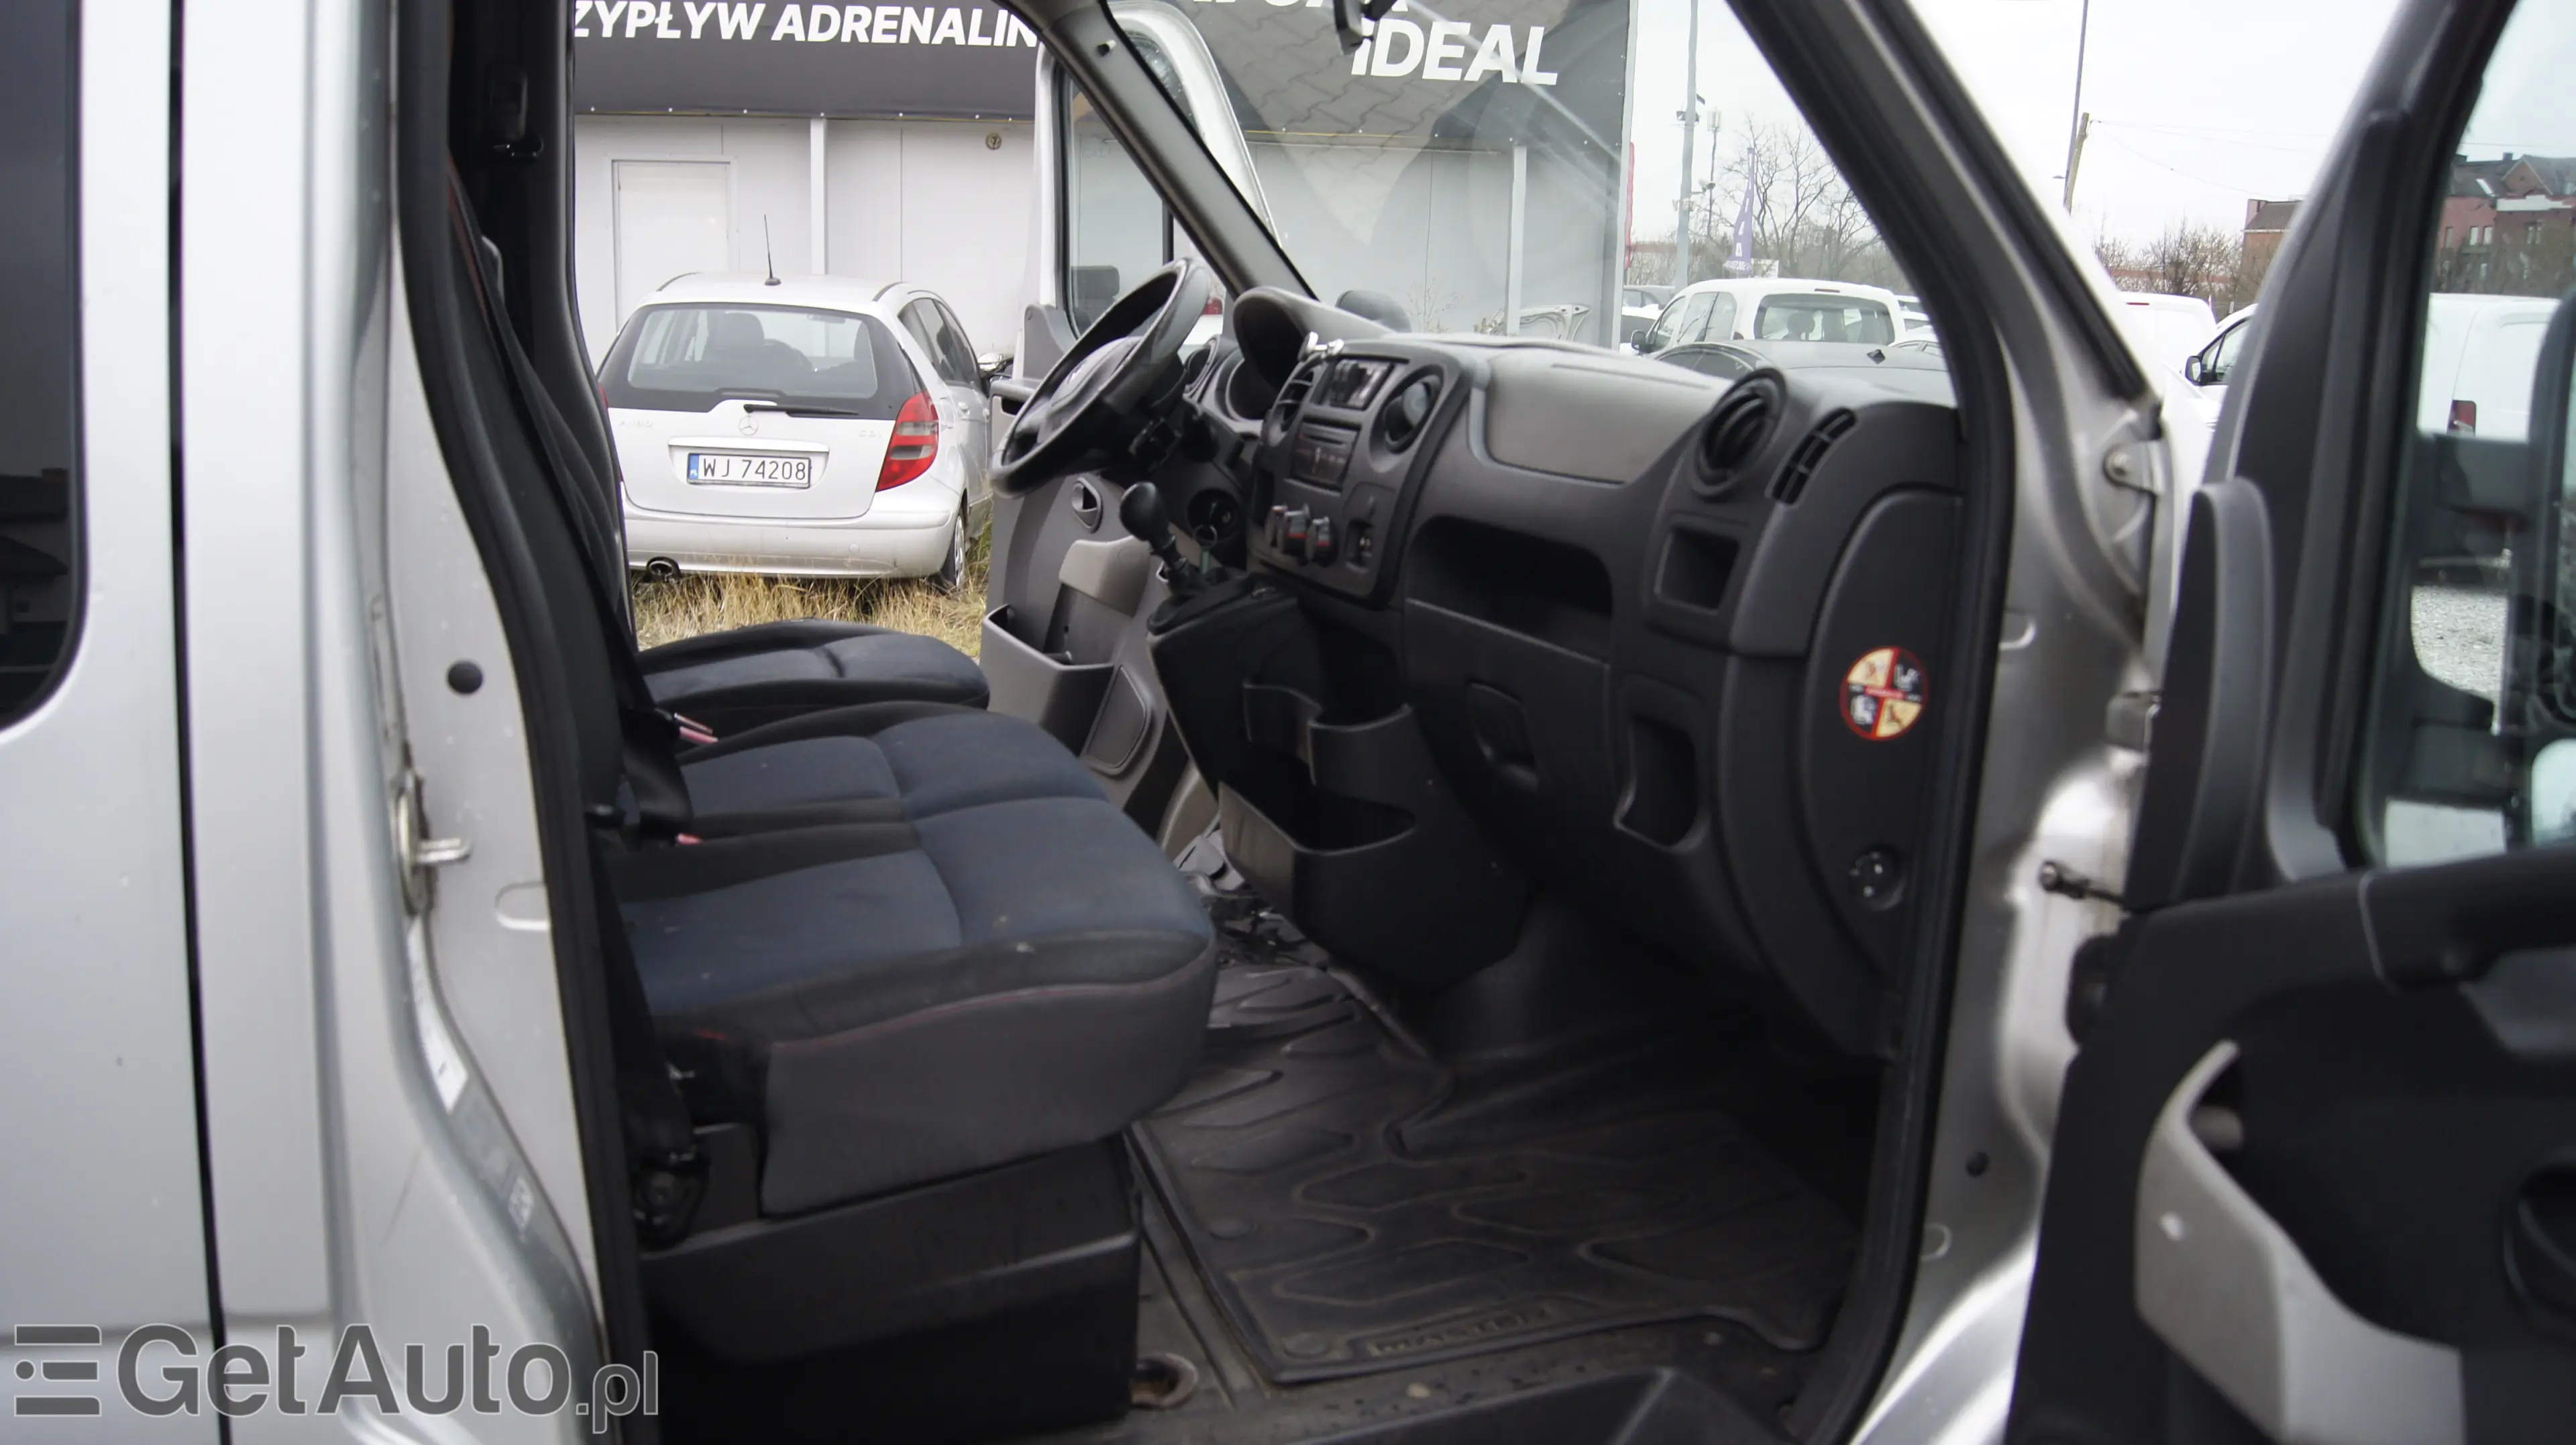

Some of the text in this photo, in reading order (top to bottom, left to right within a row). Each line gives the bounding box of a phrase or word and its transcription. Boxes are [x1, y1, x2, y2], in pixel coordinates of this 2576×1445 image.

[575, 0, 767, 40] ZYPŁYW
[1350, 17, 1558, 86] IDEAL
[703, 458, 806, 481] WJ 74208
